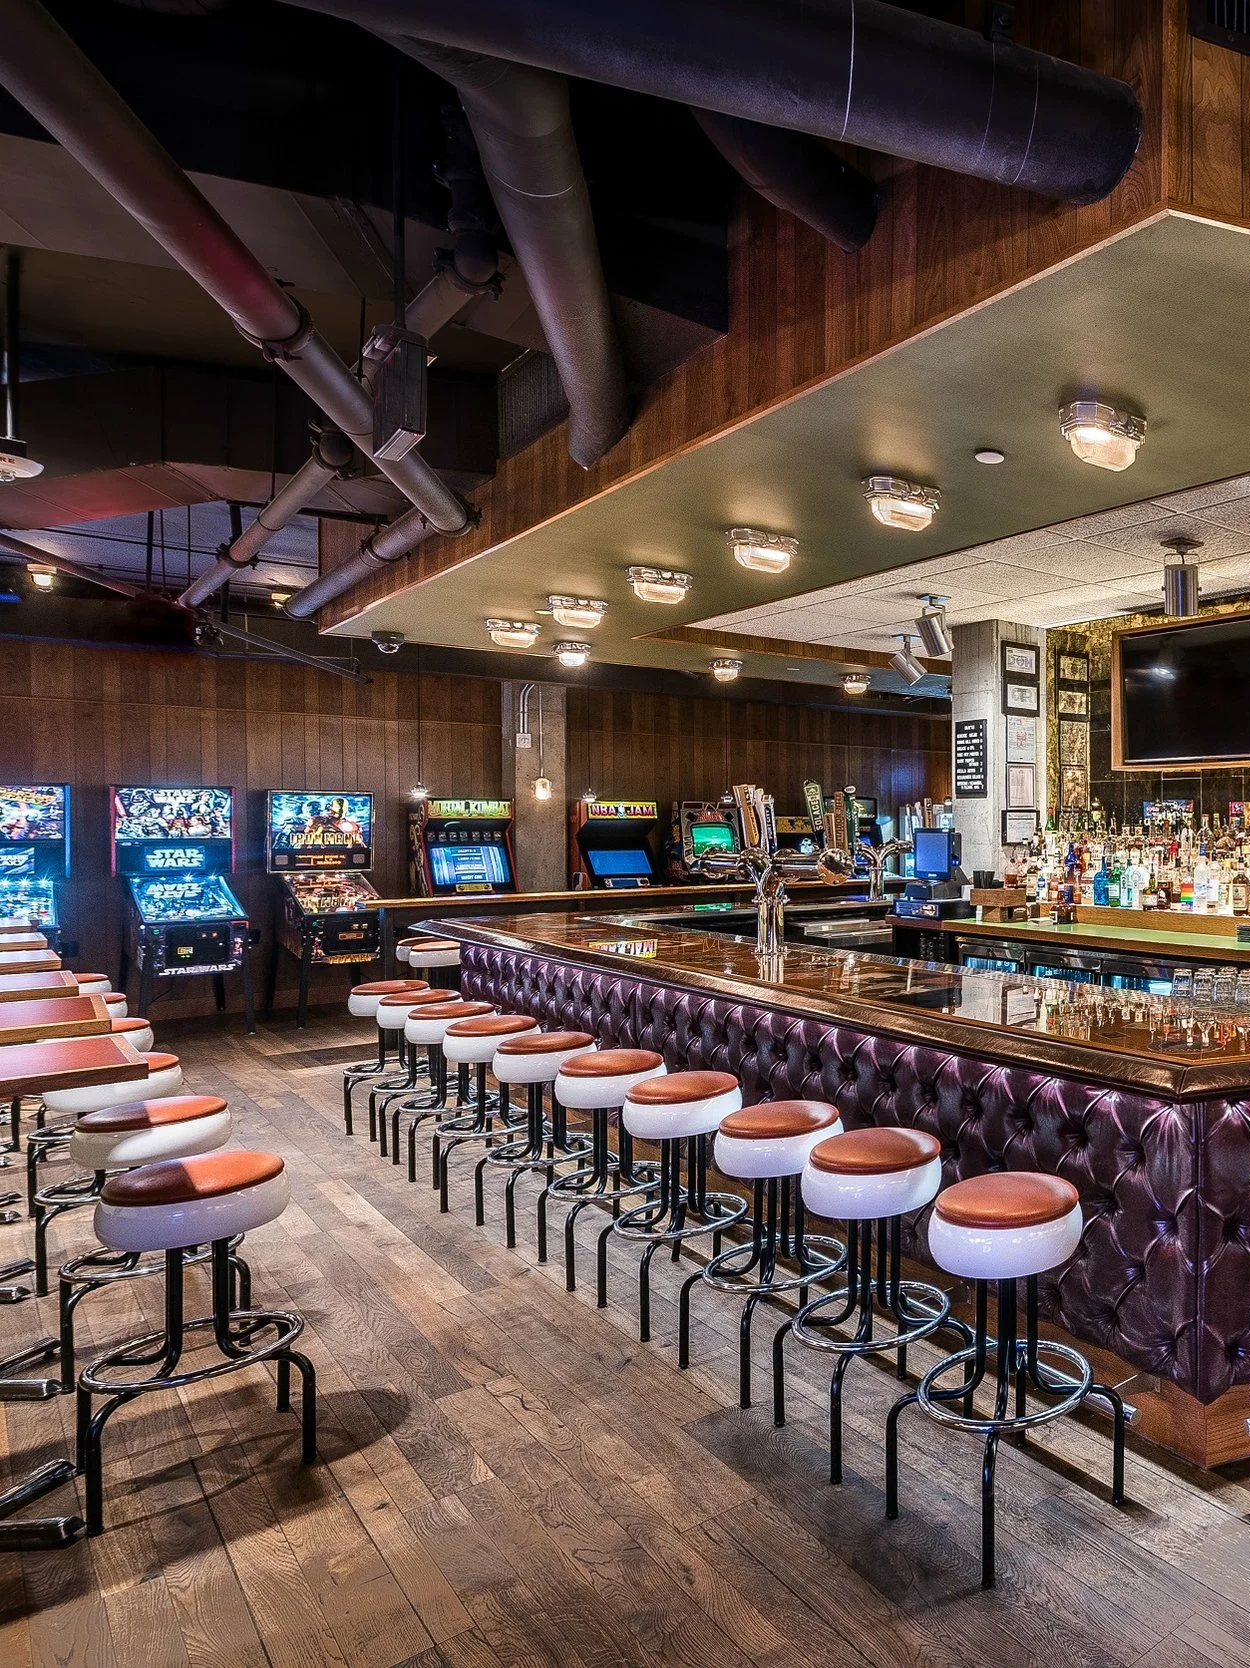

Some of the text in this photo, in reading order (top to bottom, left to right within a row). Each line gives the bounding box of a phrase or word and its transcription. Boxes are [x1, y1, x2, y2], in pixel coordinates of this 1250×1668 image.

[592, 805, 653, 816] NBA JAM
[810, 801, 824, 831] SOLACE
[146, 849, 204, 858] STAR
[146, 858, 203, 868] WARS
[159, 964, 236, 976] STAR WARS
